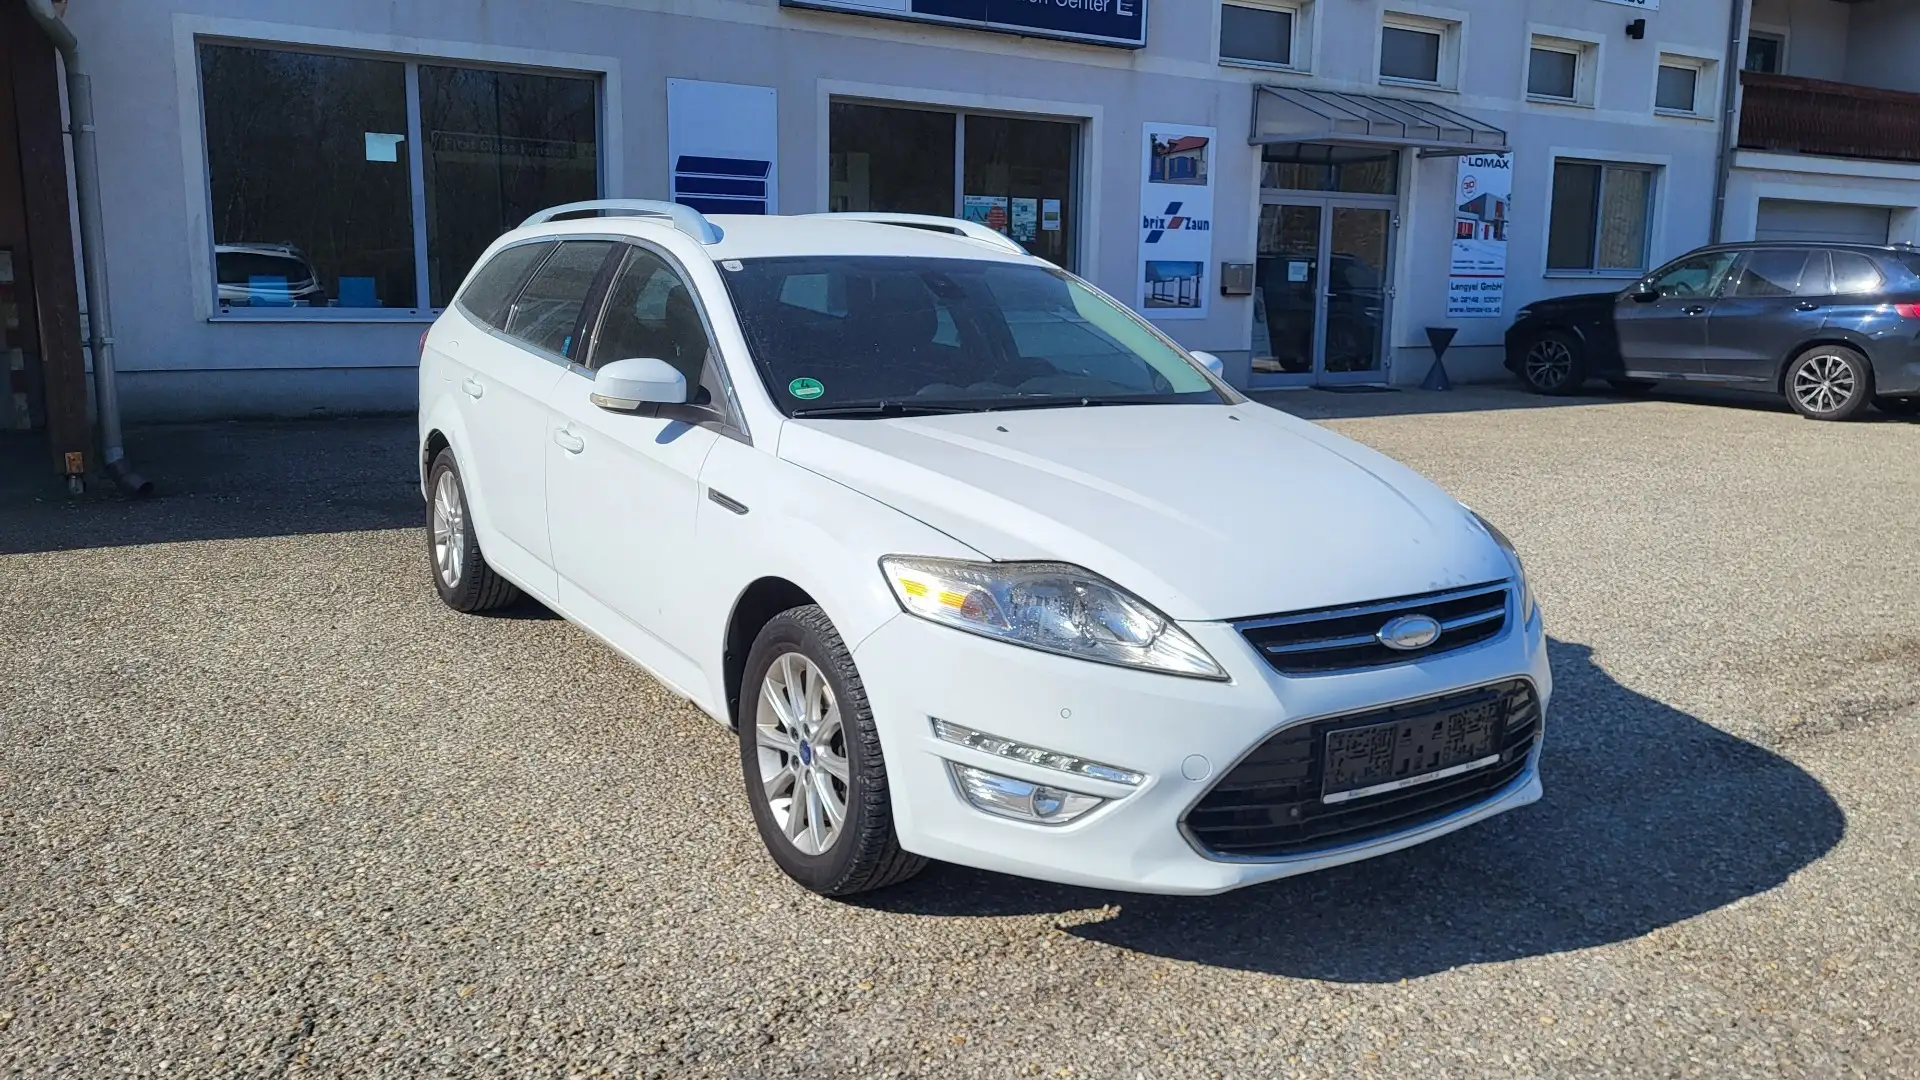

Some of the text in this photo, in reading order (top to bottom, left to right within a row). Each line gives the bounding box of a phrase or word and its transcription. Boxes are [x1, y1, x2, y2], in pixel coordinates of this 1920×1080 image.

[1469, 157, 1509, 169] LOMAX
[1143, 216, 1209, 231] brix Zaun
[1481, 282, 1502, 291] GmbH
